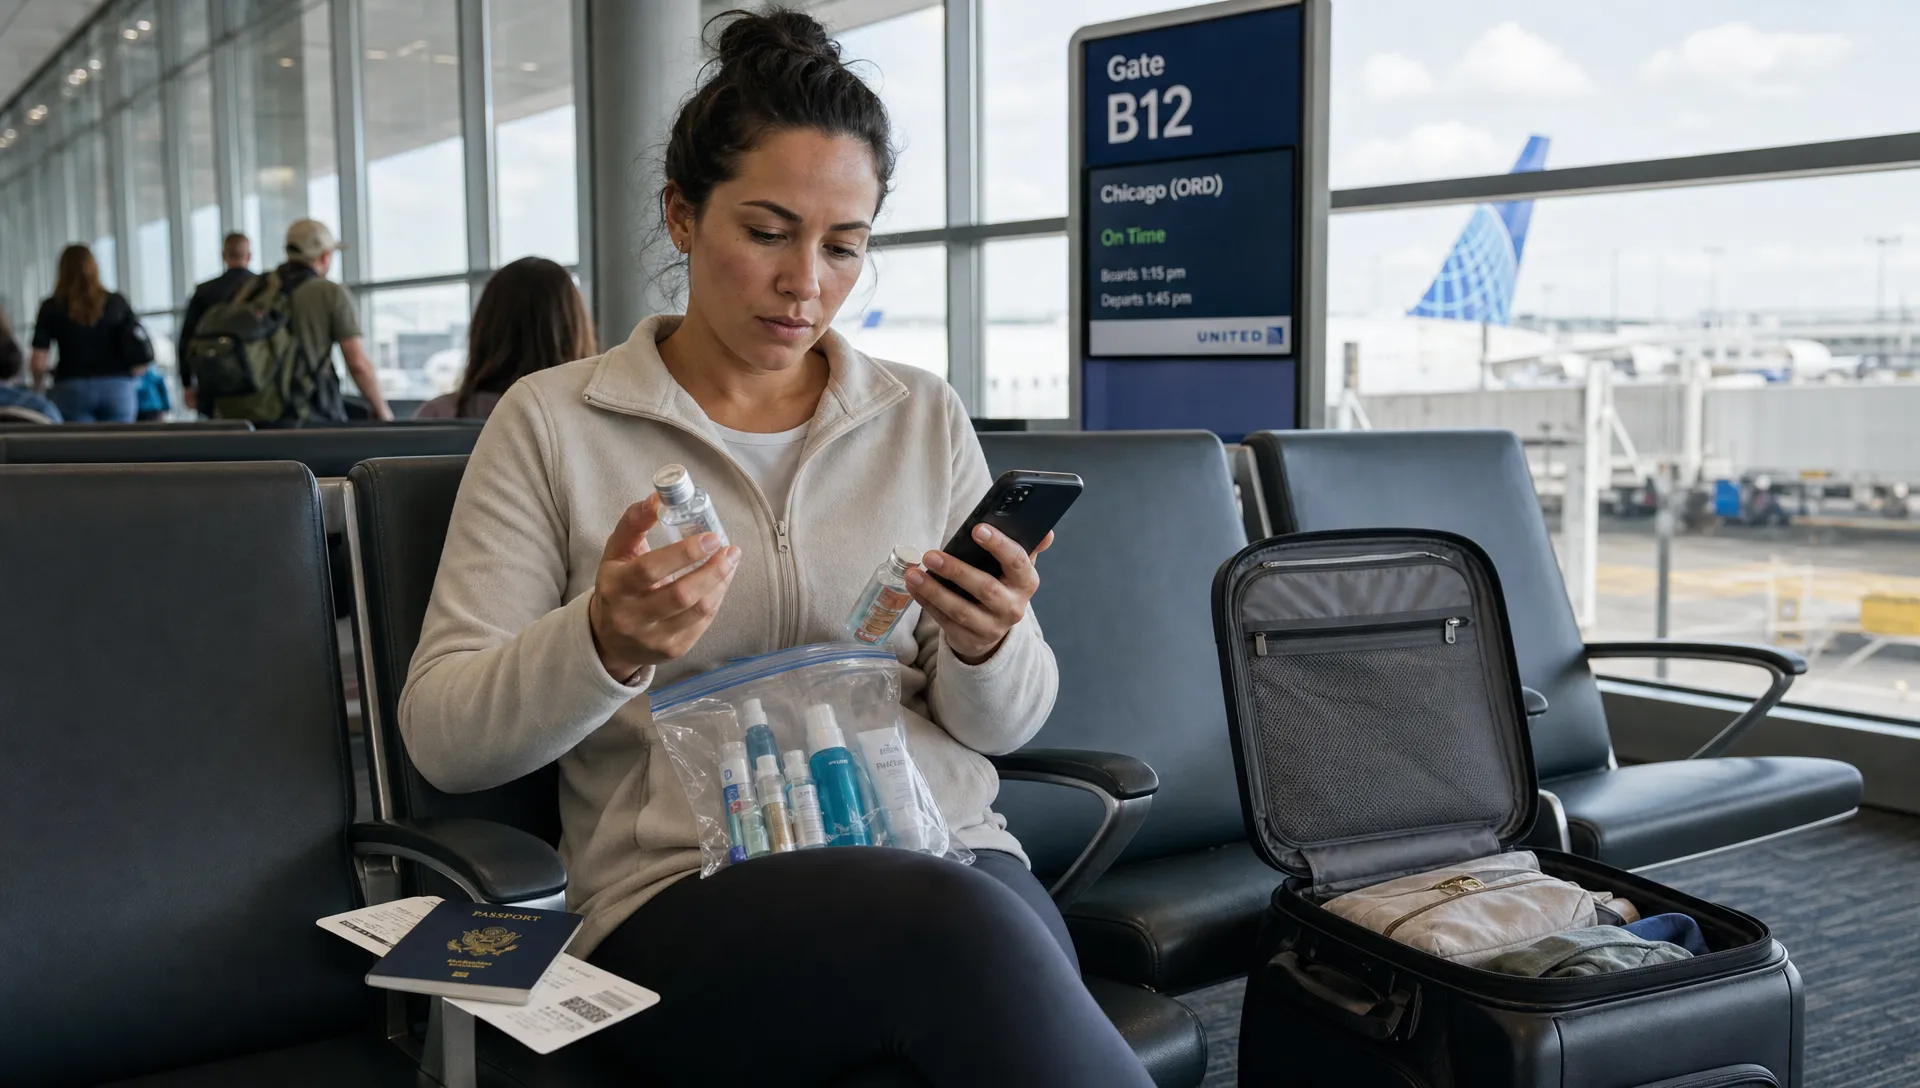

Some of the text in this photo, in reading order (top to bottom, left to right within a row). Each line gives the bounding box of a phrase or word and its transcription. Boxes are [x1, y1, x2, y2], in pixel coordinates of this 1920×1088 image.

[1107, 53, 1165, 82] Gate
[1108, 84, 1193, 144] B12
[1101, 173, 1223, 205] Chicago (ORD)
[1101, 227, 1167, 247] On Time
[1101, 266, 1186, 283] Boards 1:15 pm
[1101, 291, 1192, 310] Departs 1:45 pm
[1197, 330, 1262, 343] UNITED
[472, 910, 541, 921] PASSPORT
